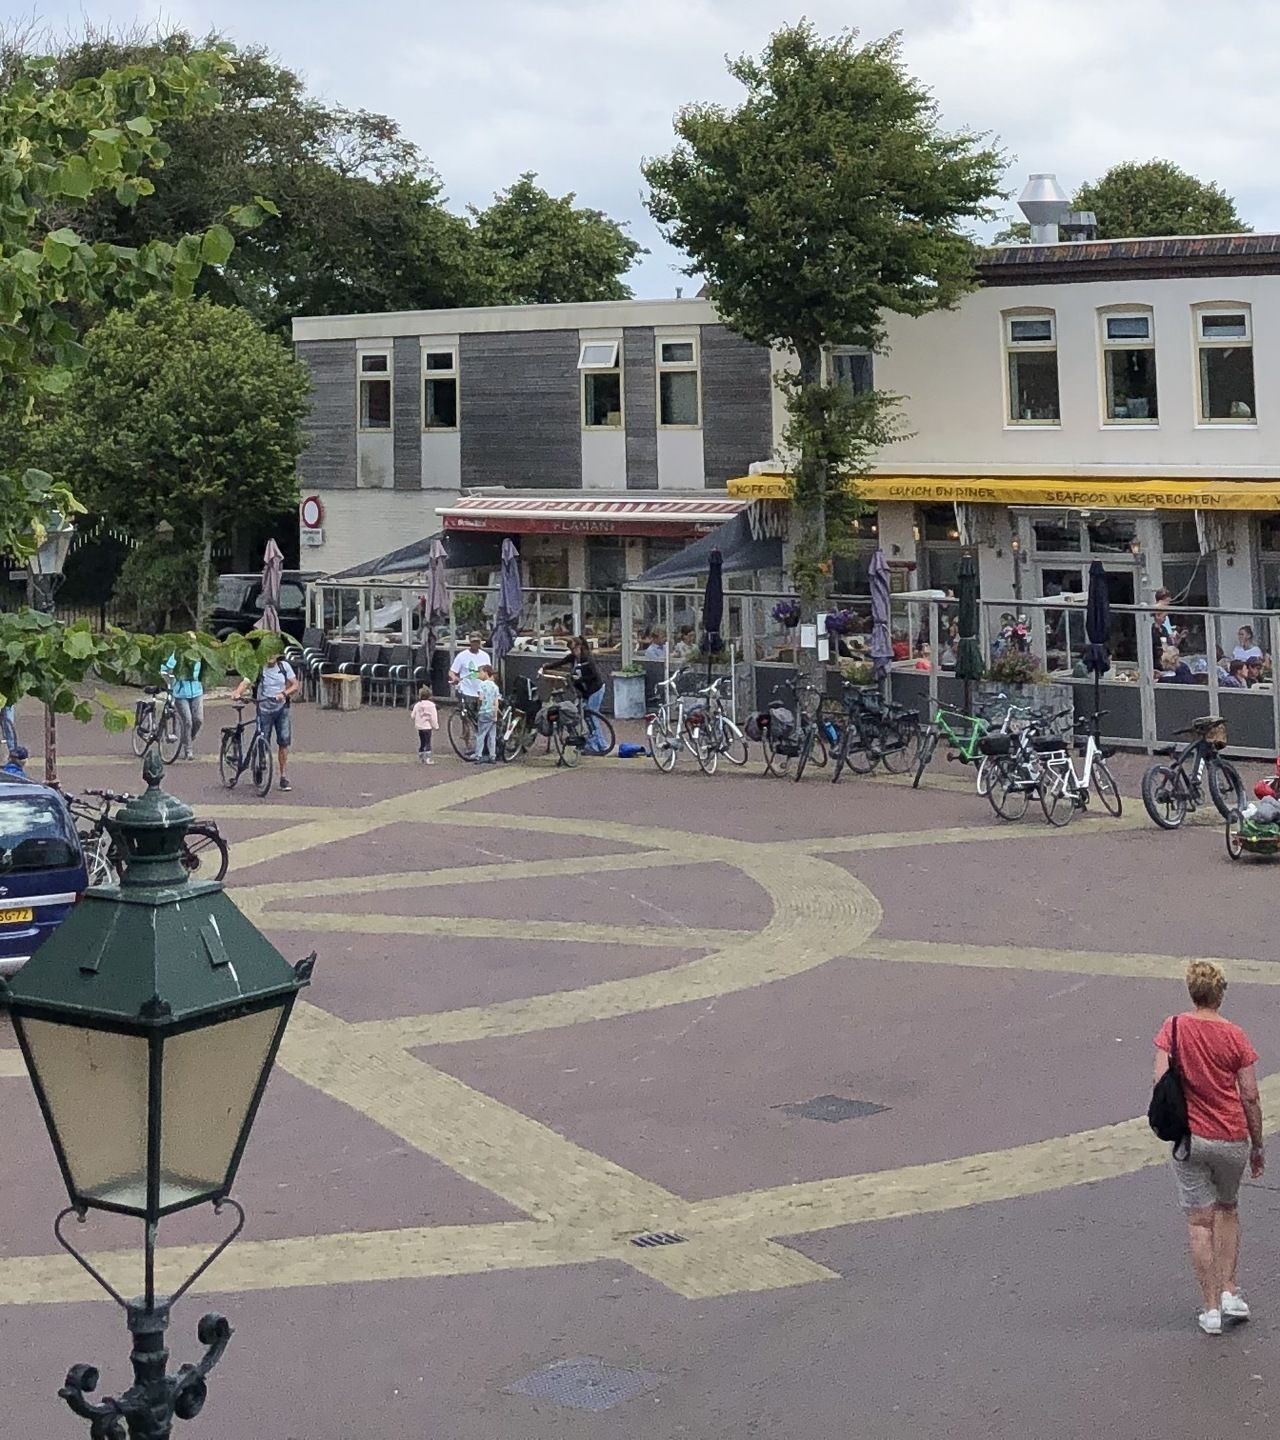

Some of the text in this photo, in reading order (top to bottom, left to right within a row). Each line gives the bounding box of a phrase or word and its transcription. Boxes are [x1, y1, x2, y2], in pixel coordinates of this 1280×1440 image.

[736, 484, 774, 496] KOFFIE
[889, 486, 996, 498] LUNCH EN DINER
[1045, 491, 1220, 506] SEAFOOD VISGERECHTEN
